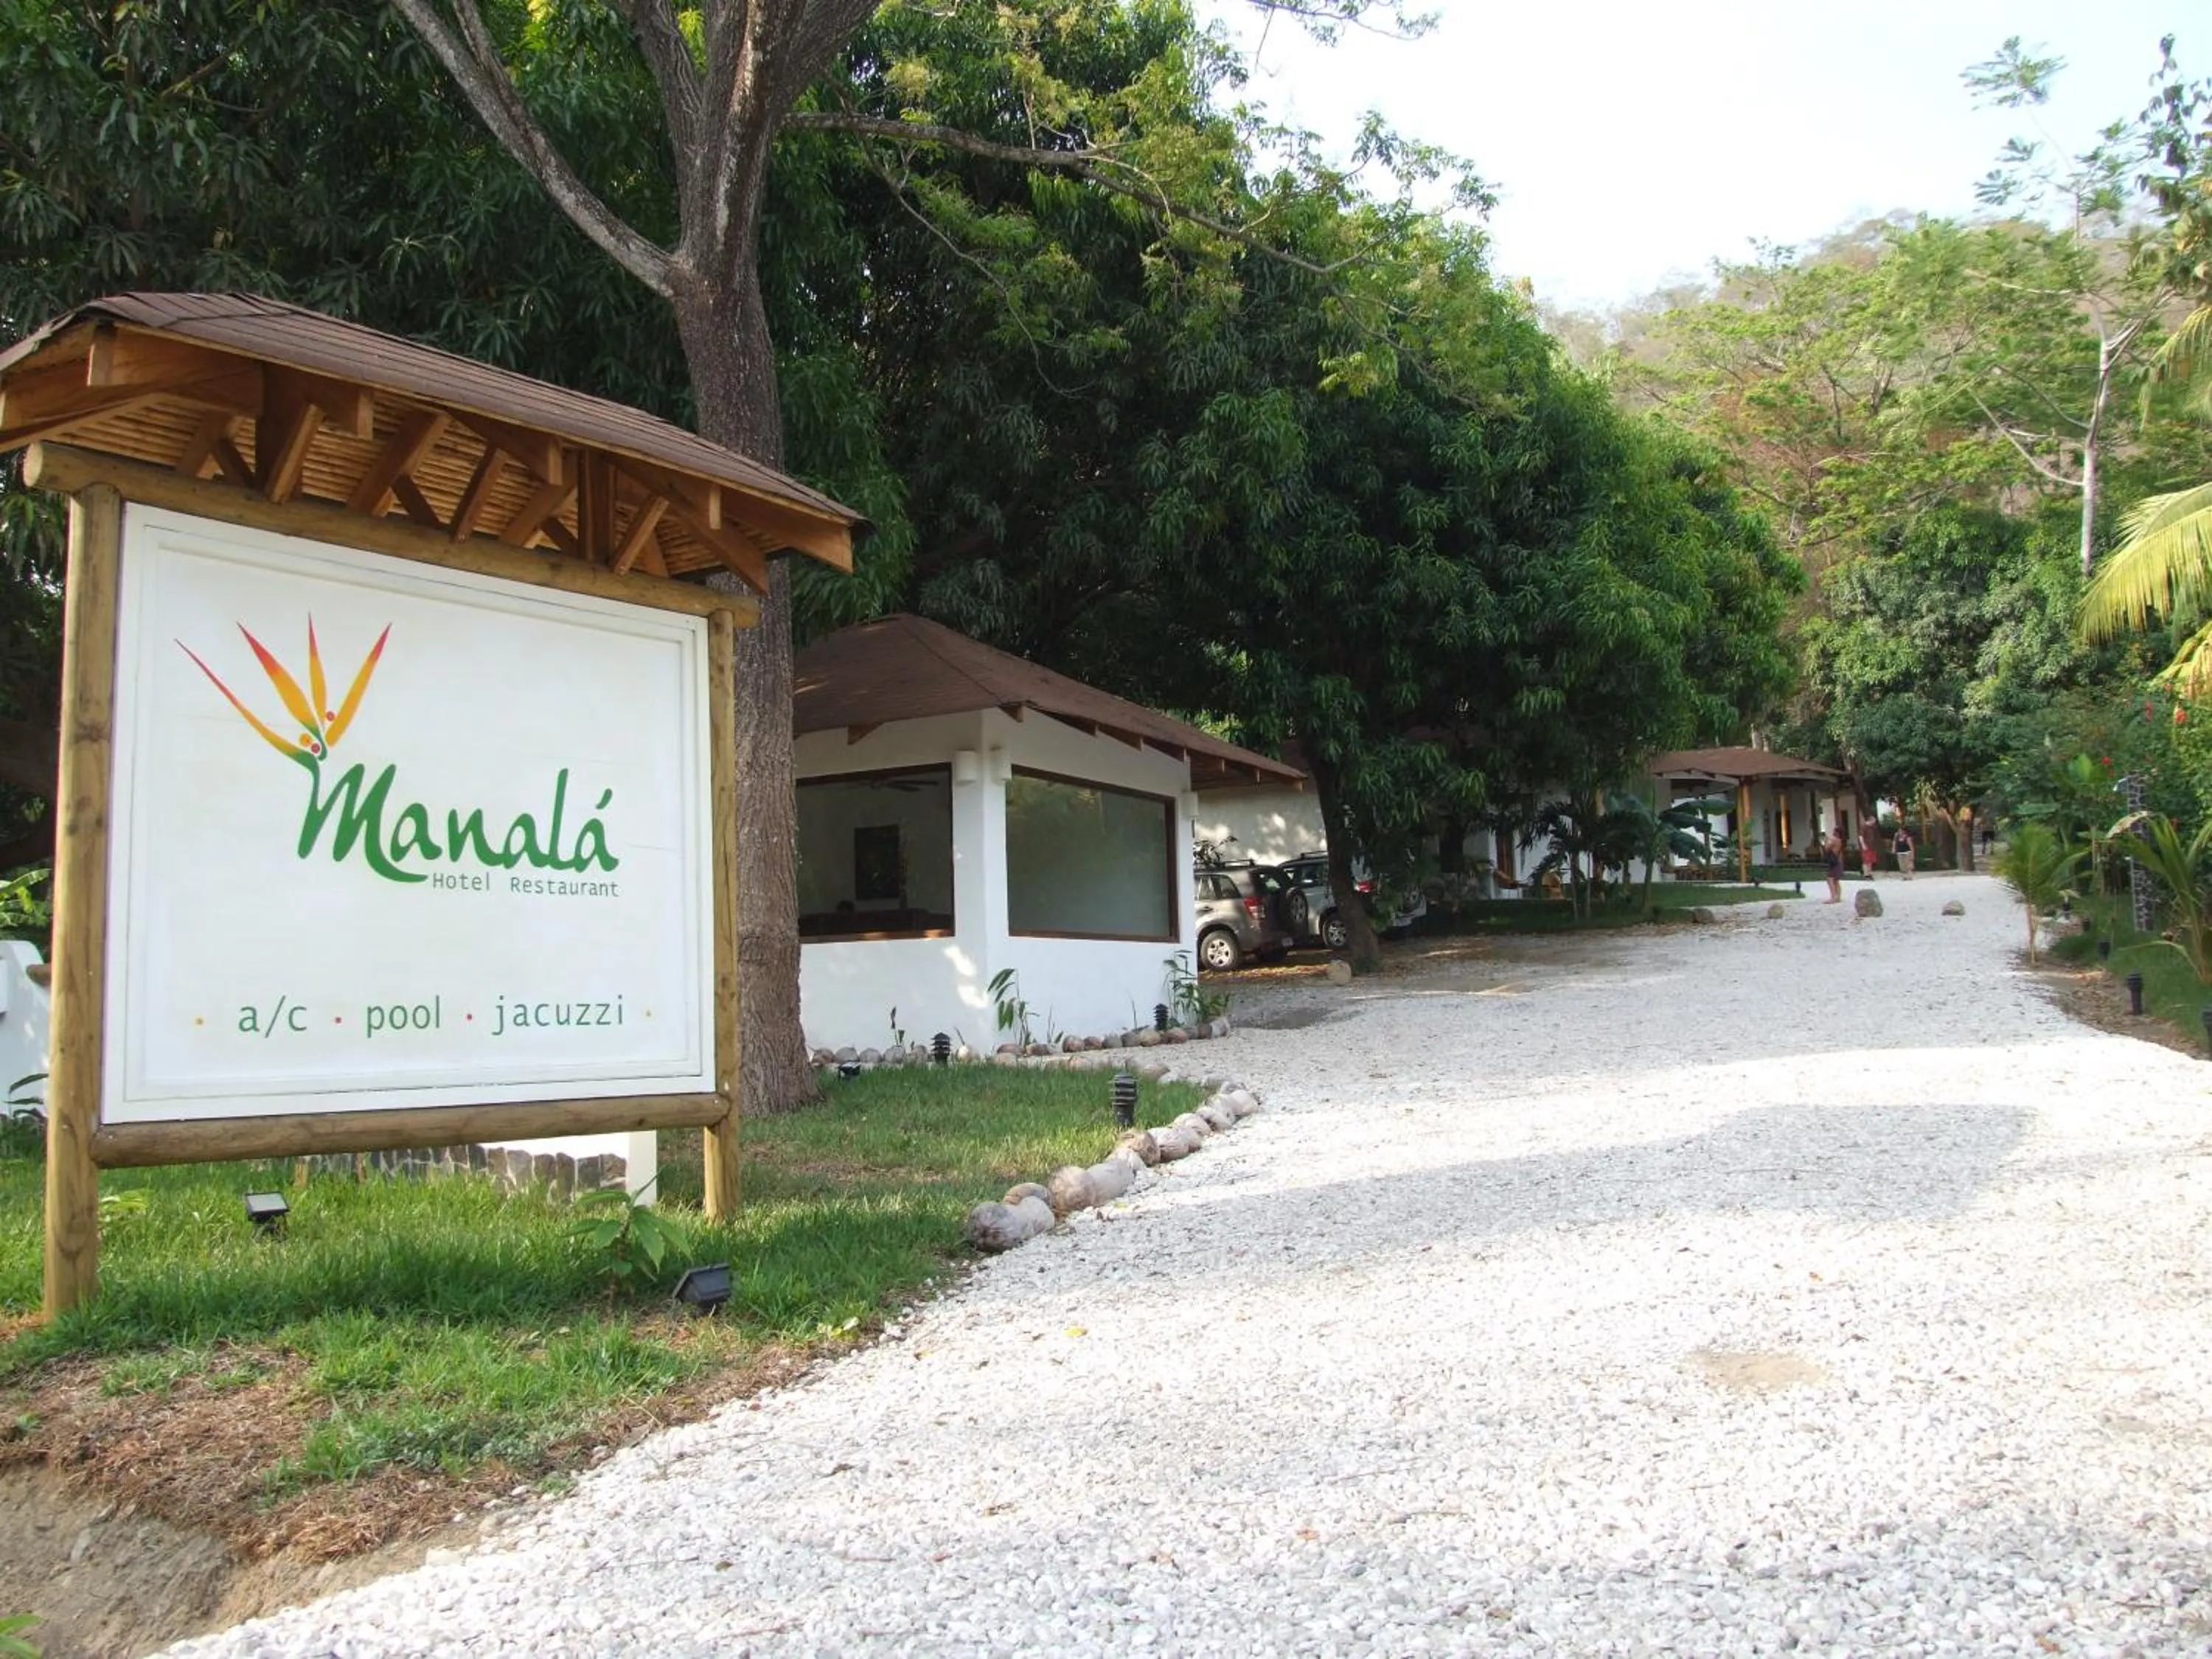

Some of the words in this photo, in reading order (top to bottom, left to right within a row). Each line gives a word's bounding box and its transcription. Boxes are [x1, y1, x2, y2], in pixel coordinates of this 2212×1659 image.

[297, 755, 619, 883] Manalá
[432, 872, 491, 891] Hotel
[510, 876, 619, 897] Restaurant
[237, 995, 307, 1038] a/c
[366, 995, 441, 1037] pool
[491, 994, 624, 1035] jacuzzi
